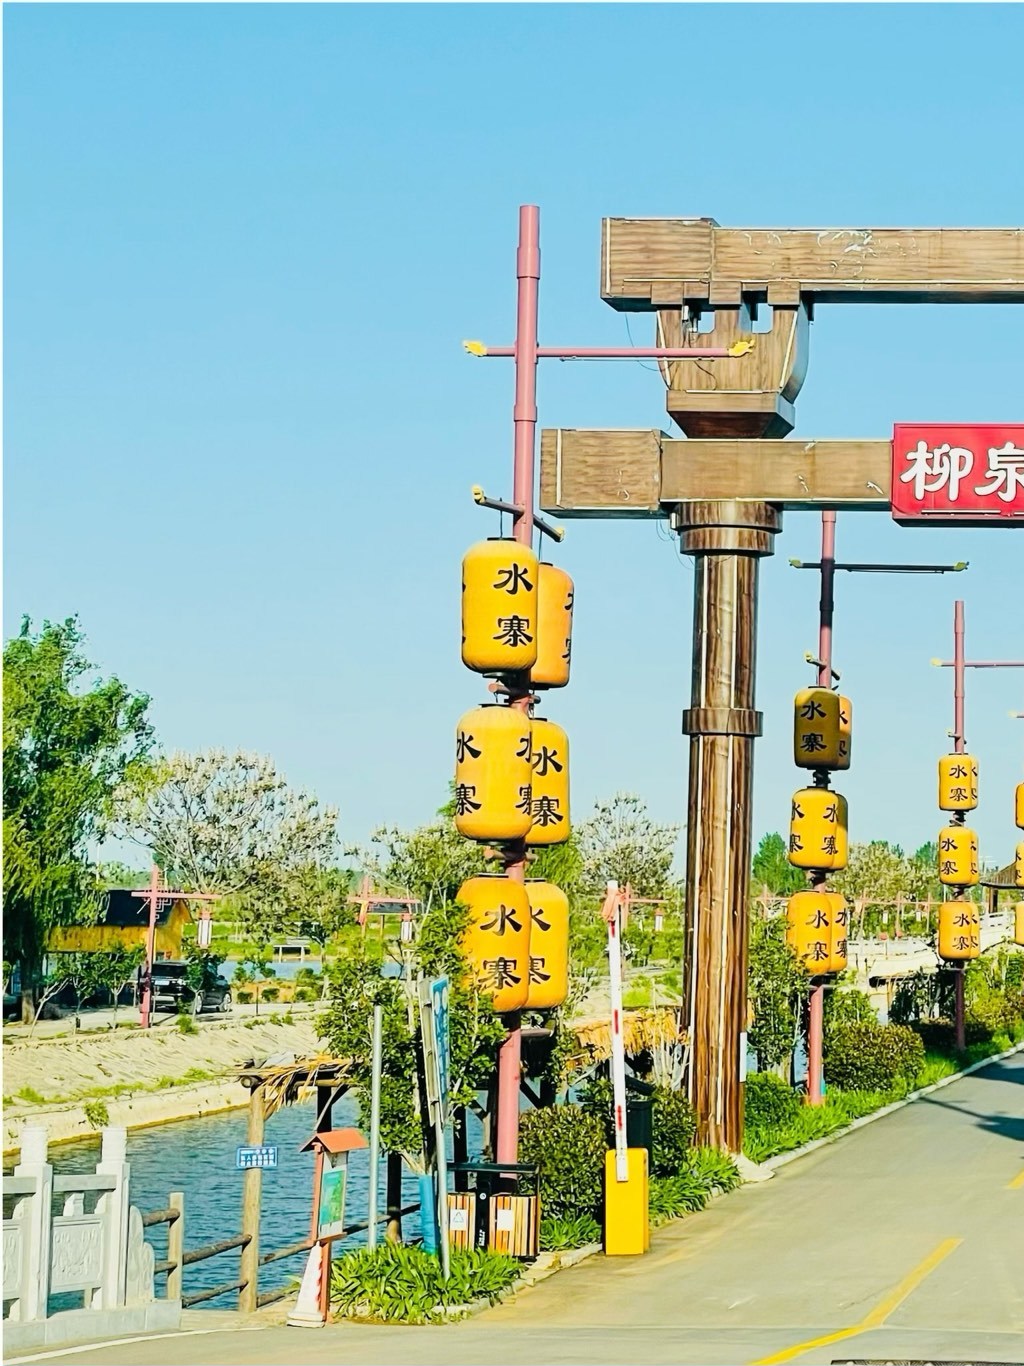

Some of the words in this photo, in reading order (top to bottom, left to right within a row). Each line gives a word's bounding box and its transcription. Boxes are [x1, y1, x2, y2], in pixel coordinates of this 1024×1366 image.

[493, 563, 534, 648] 水寨
[800, 701, 828, 753] 水寨
[531, 746, 564, 827] 水寨
[949, 765, 969, 802] 水寨
[941, 837, 959, 876] 水寨
[478, 904, 523, 990] 水寨
[806, 910, 830, 962] 水寨
[952, 913, 971, 951] 水寨
